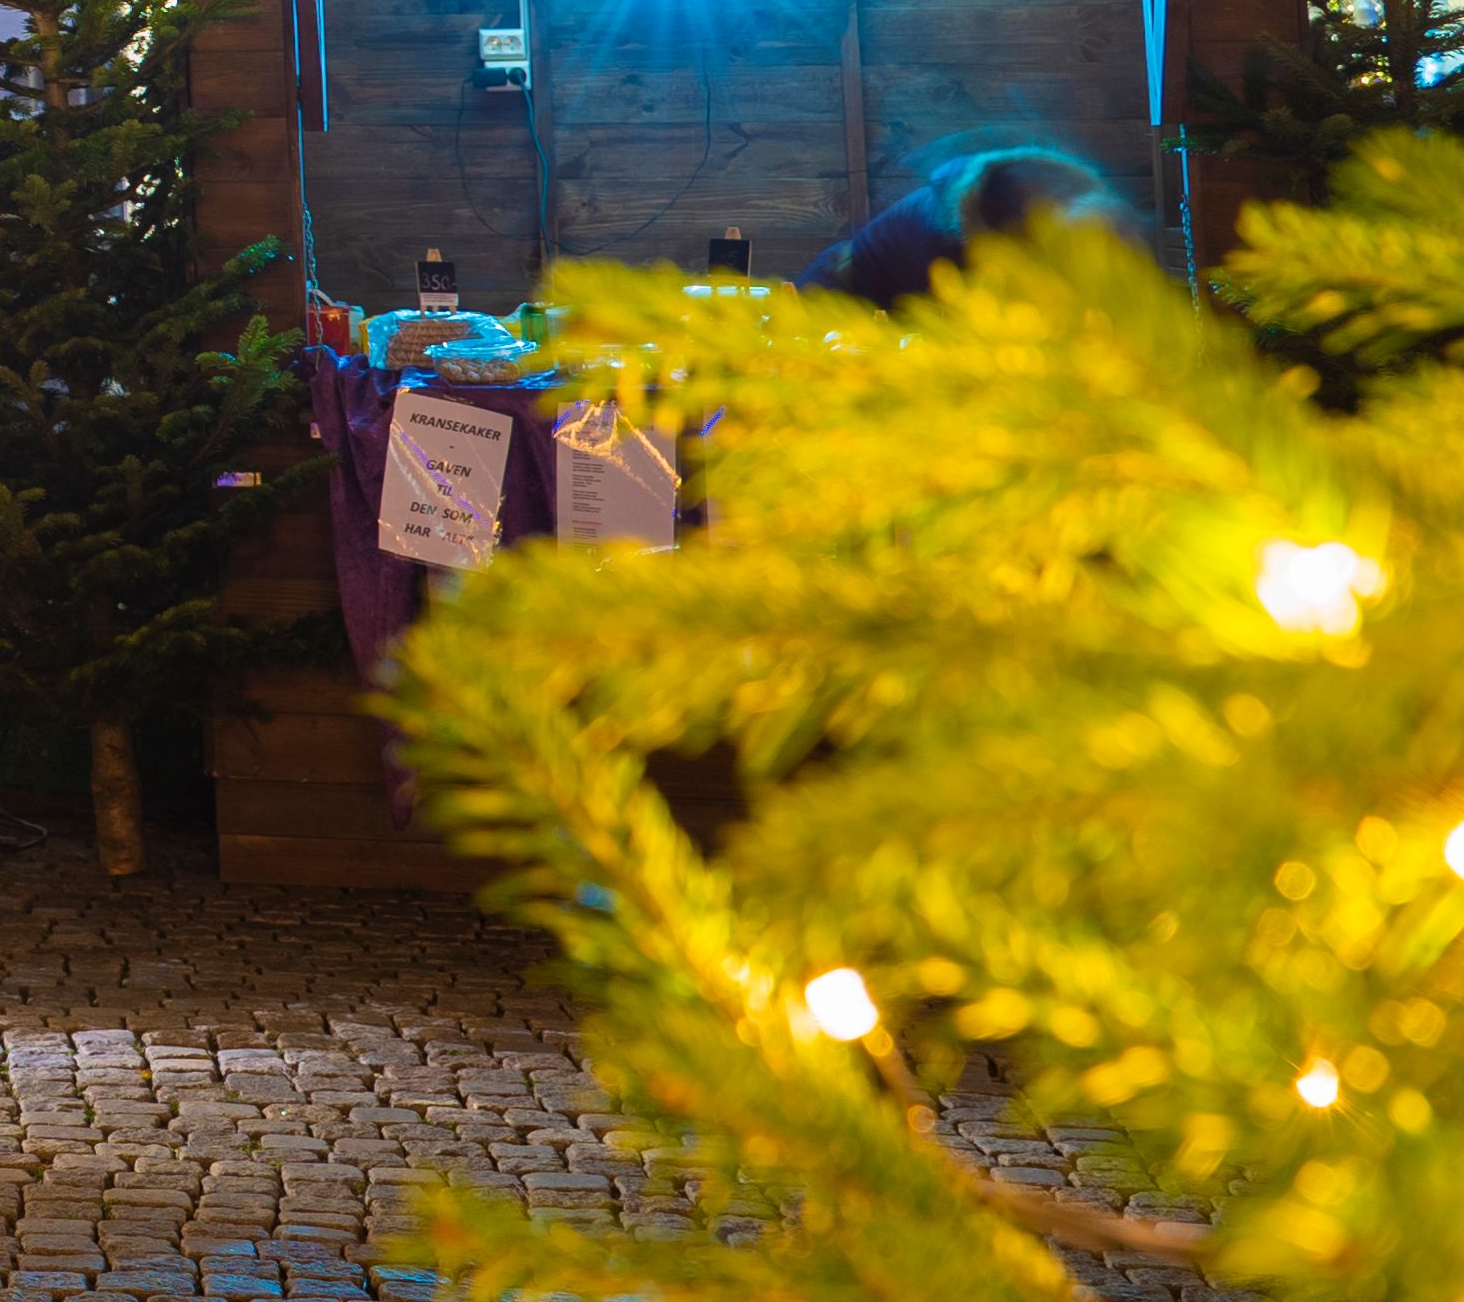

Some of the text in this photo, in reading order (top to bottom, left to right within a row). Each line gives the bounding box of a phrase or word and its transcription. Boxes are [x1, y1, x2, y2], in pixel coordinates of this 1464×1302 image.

[410, 413, 502, 441] KRANSEKAKER
[426, 459, 472, 478] GAVEN
[410, 501, 473, 524] DEN SOM
[404, 523, 432, 539] HAR
